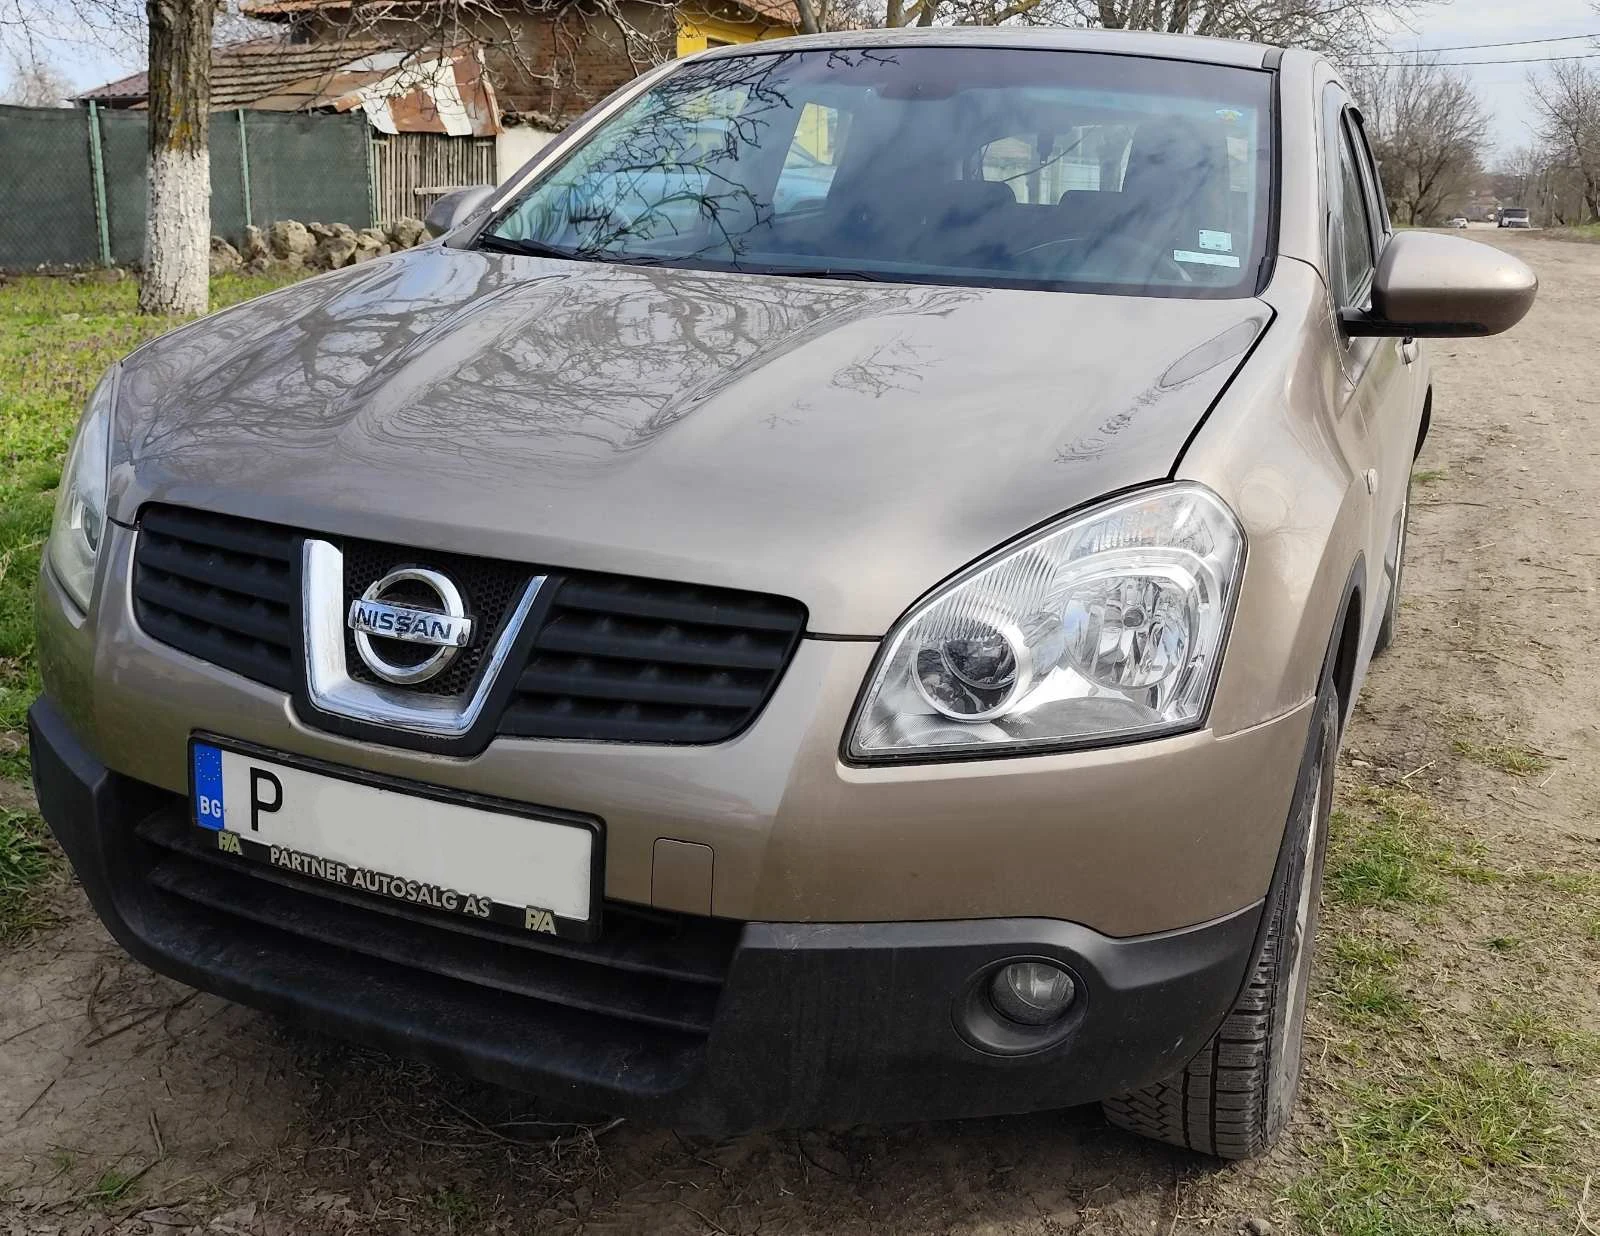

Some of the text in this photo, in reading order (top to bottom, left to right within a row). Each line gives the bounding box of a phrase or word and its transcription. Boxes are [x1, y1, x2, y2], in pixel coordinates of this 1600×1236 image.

[356, 607, 452, 640] NISSAN
[199, 795, 222, 818] BG
[250, 766, 283, 832] P
[269, 847, 490, 918] PARTNER AUTOSALG AS
